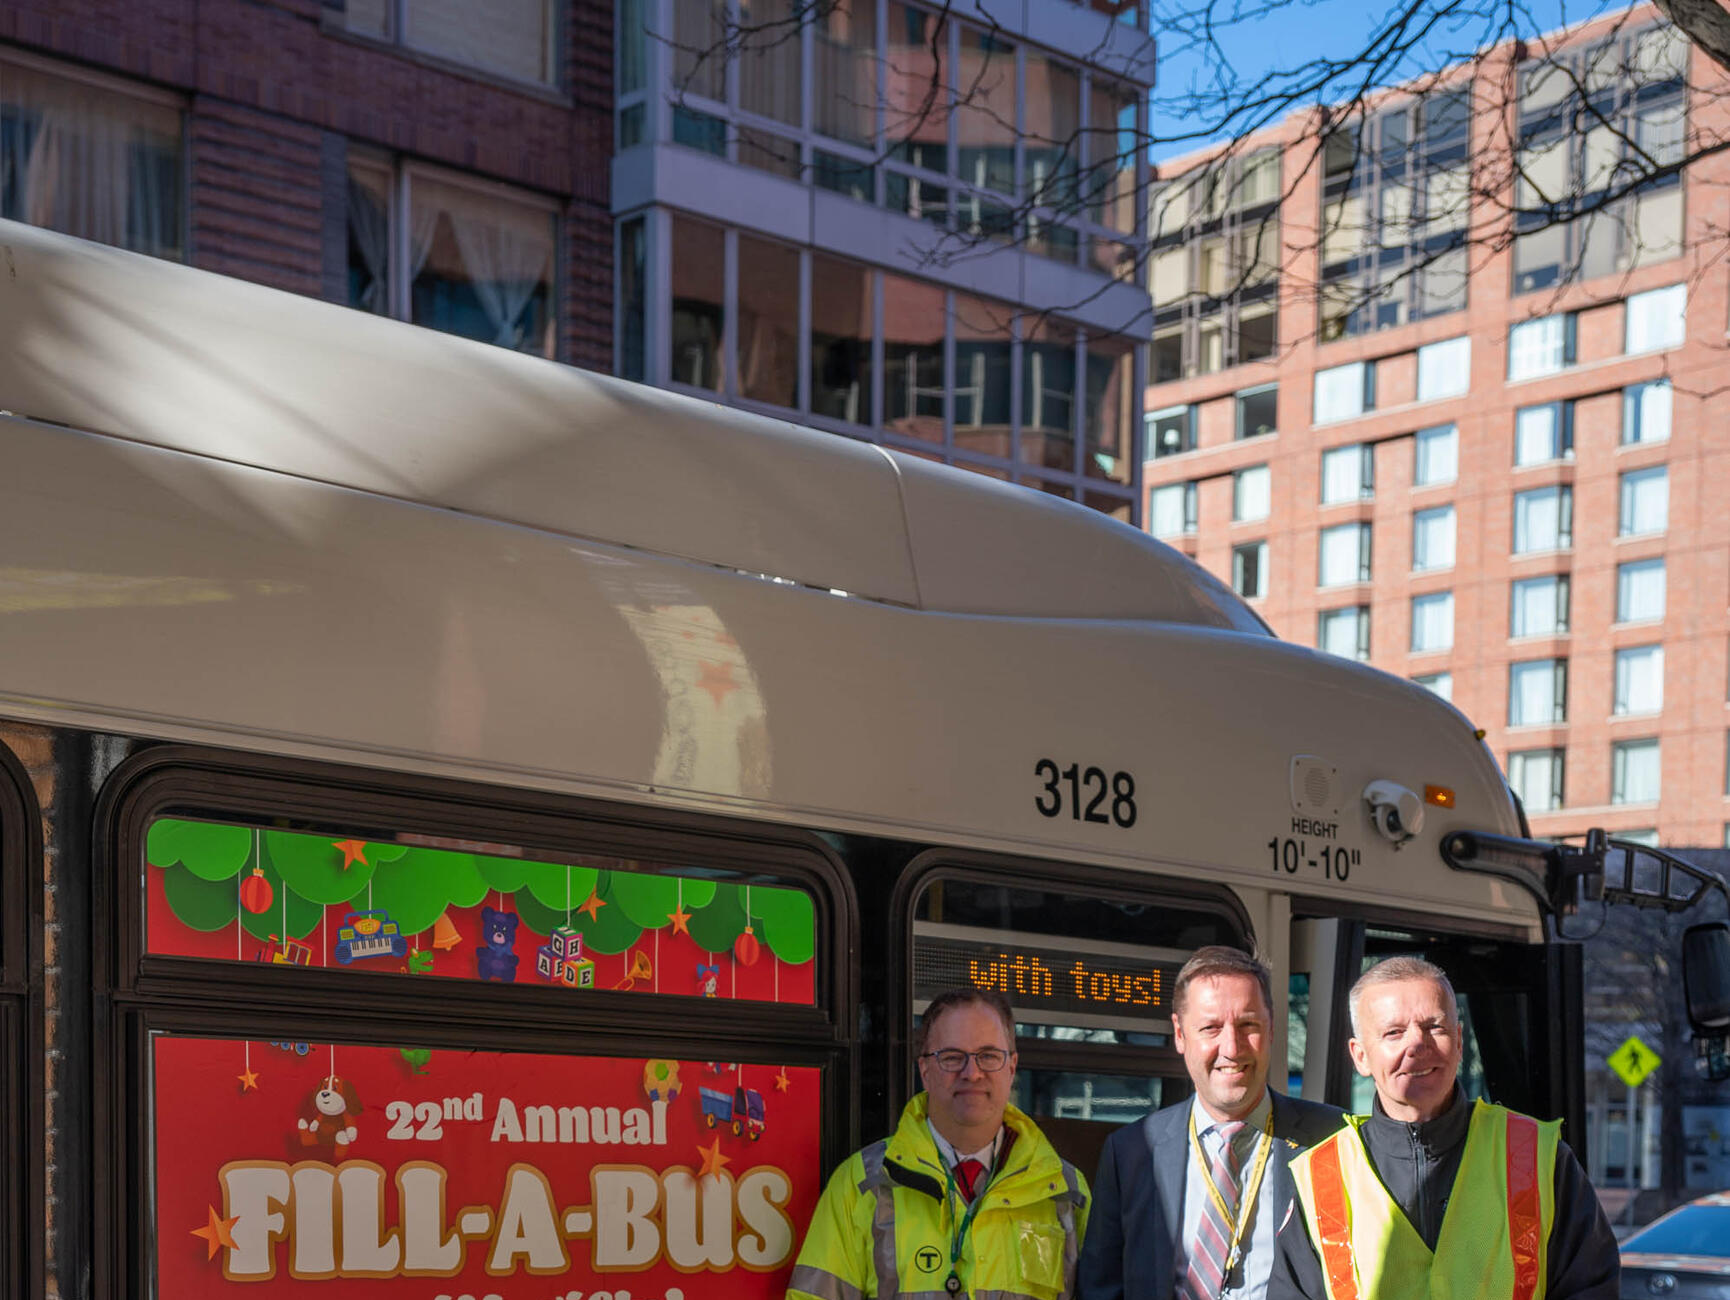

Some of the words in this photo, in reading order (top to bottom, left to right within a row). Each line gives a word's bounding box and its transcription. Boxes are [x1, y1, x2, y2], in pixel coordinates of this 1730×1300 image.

[1034, 759, 1137, 828] 3128
[1291, 818, 1339, 840] HEIGHT
[1268, 838, 1361, 882] 10'-10"
[969, 953, 1054, 998] with
[1073, 961, 1162, 1006] toys!
[384, 1092, 483, 1142] 22nd
[490, 1097, 668, 1147] Annual
[218, 1159, 796, 1282] FILL-A-BUS
